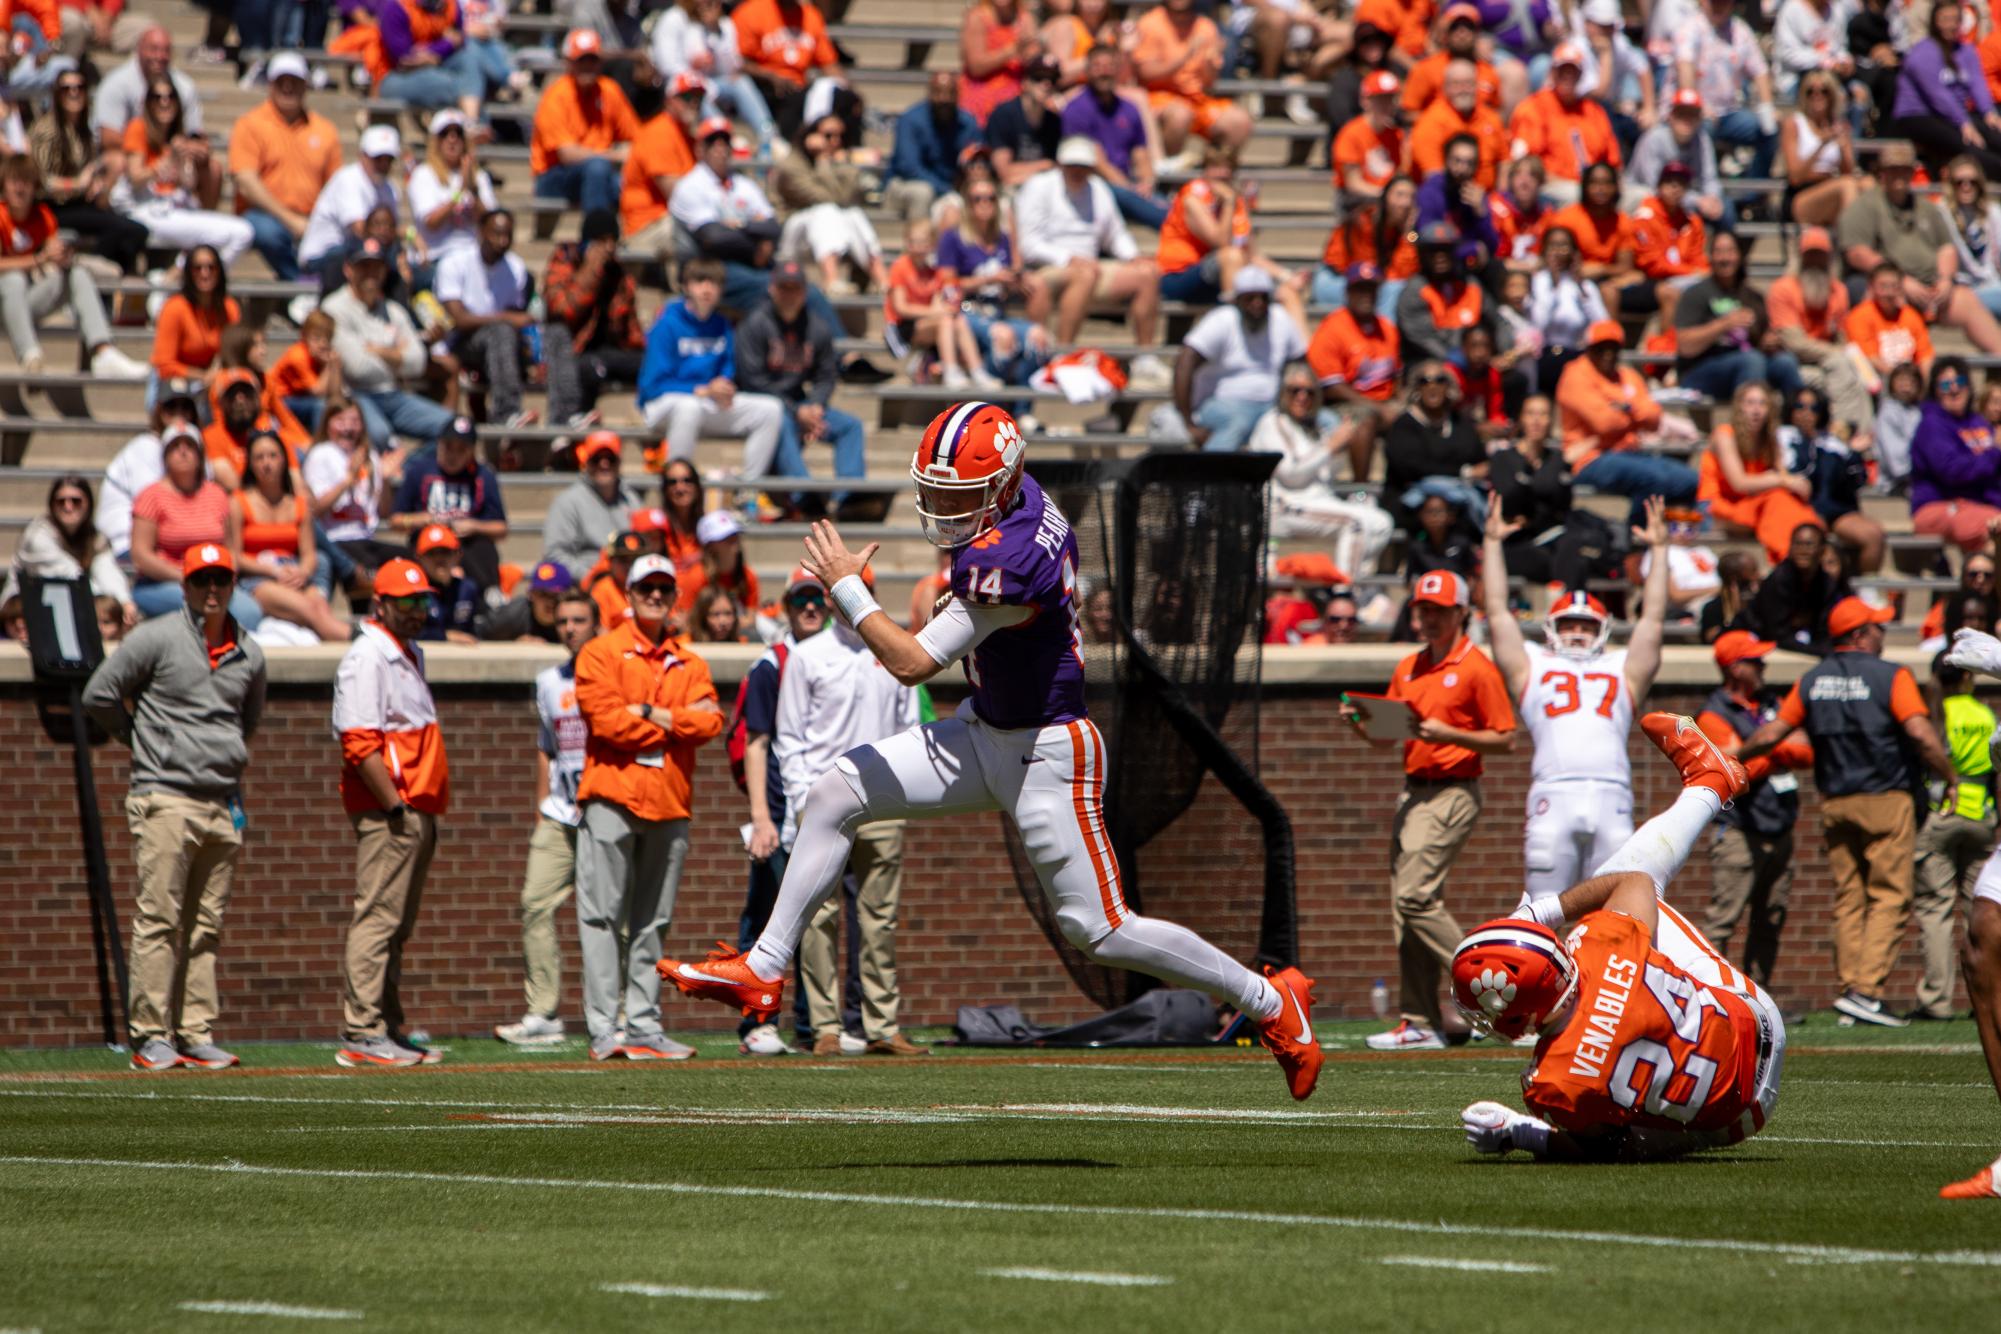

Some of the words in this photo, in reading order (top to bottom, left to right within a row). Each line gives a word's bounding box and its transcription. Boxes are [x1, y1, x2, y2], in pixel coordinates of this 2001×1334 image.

[41, 583, 83, 661] 1
[968, 567, 1003, 603] 14
[1540, 670, 1619, 721] 37
[1569, 954, 1638, 1078] VENABLES
[1607, 961, 1729, 1125] 24
